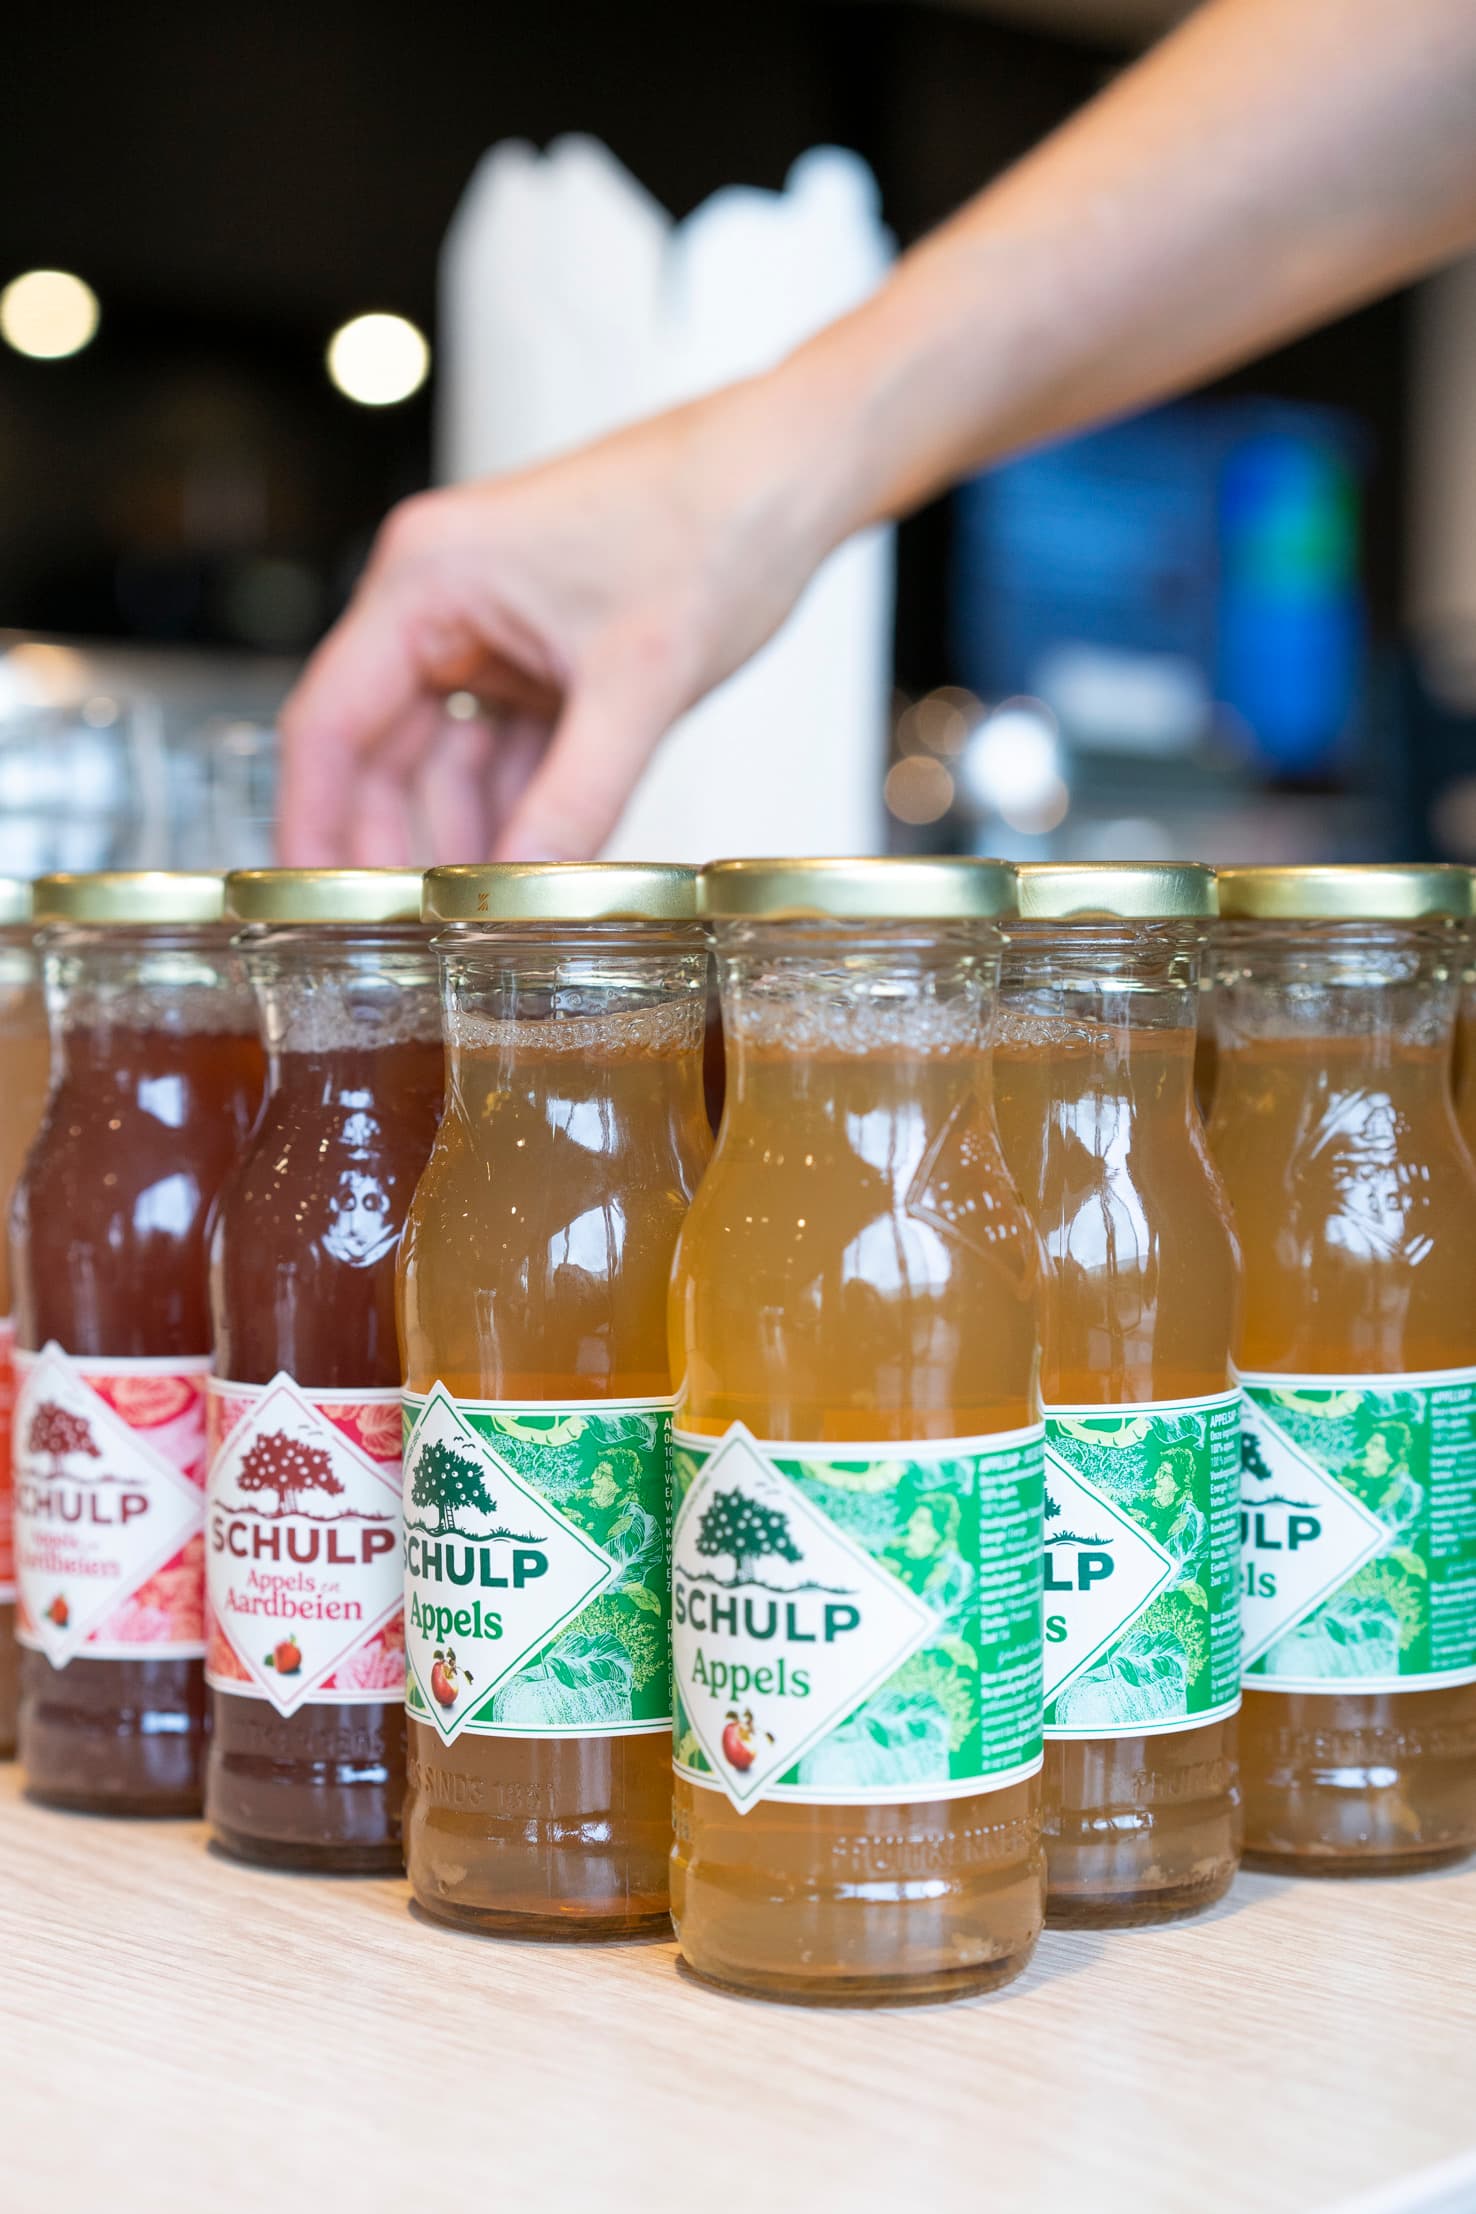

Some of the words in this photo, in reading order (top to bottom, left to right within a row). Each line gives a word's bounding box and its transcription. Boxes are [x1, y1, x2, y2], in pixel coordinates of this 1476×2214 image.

[17, 1485, 149, 1526] CHULP
[213, 1516, 396, 1564] SCHULP
[226, 1586, 363, 1620] Aardbeien
[247, 1568, 316, 1592] Appels
[410, 1591, 503, 1643] Appels
[675, 1582, 861, 1642] SCHULP
[691, 1646, 811, 1701] Appels
